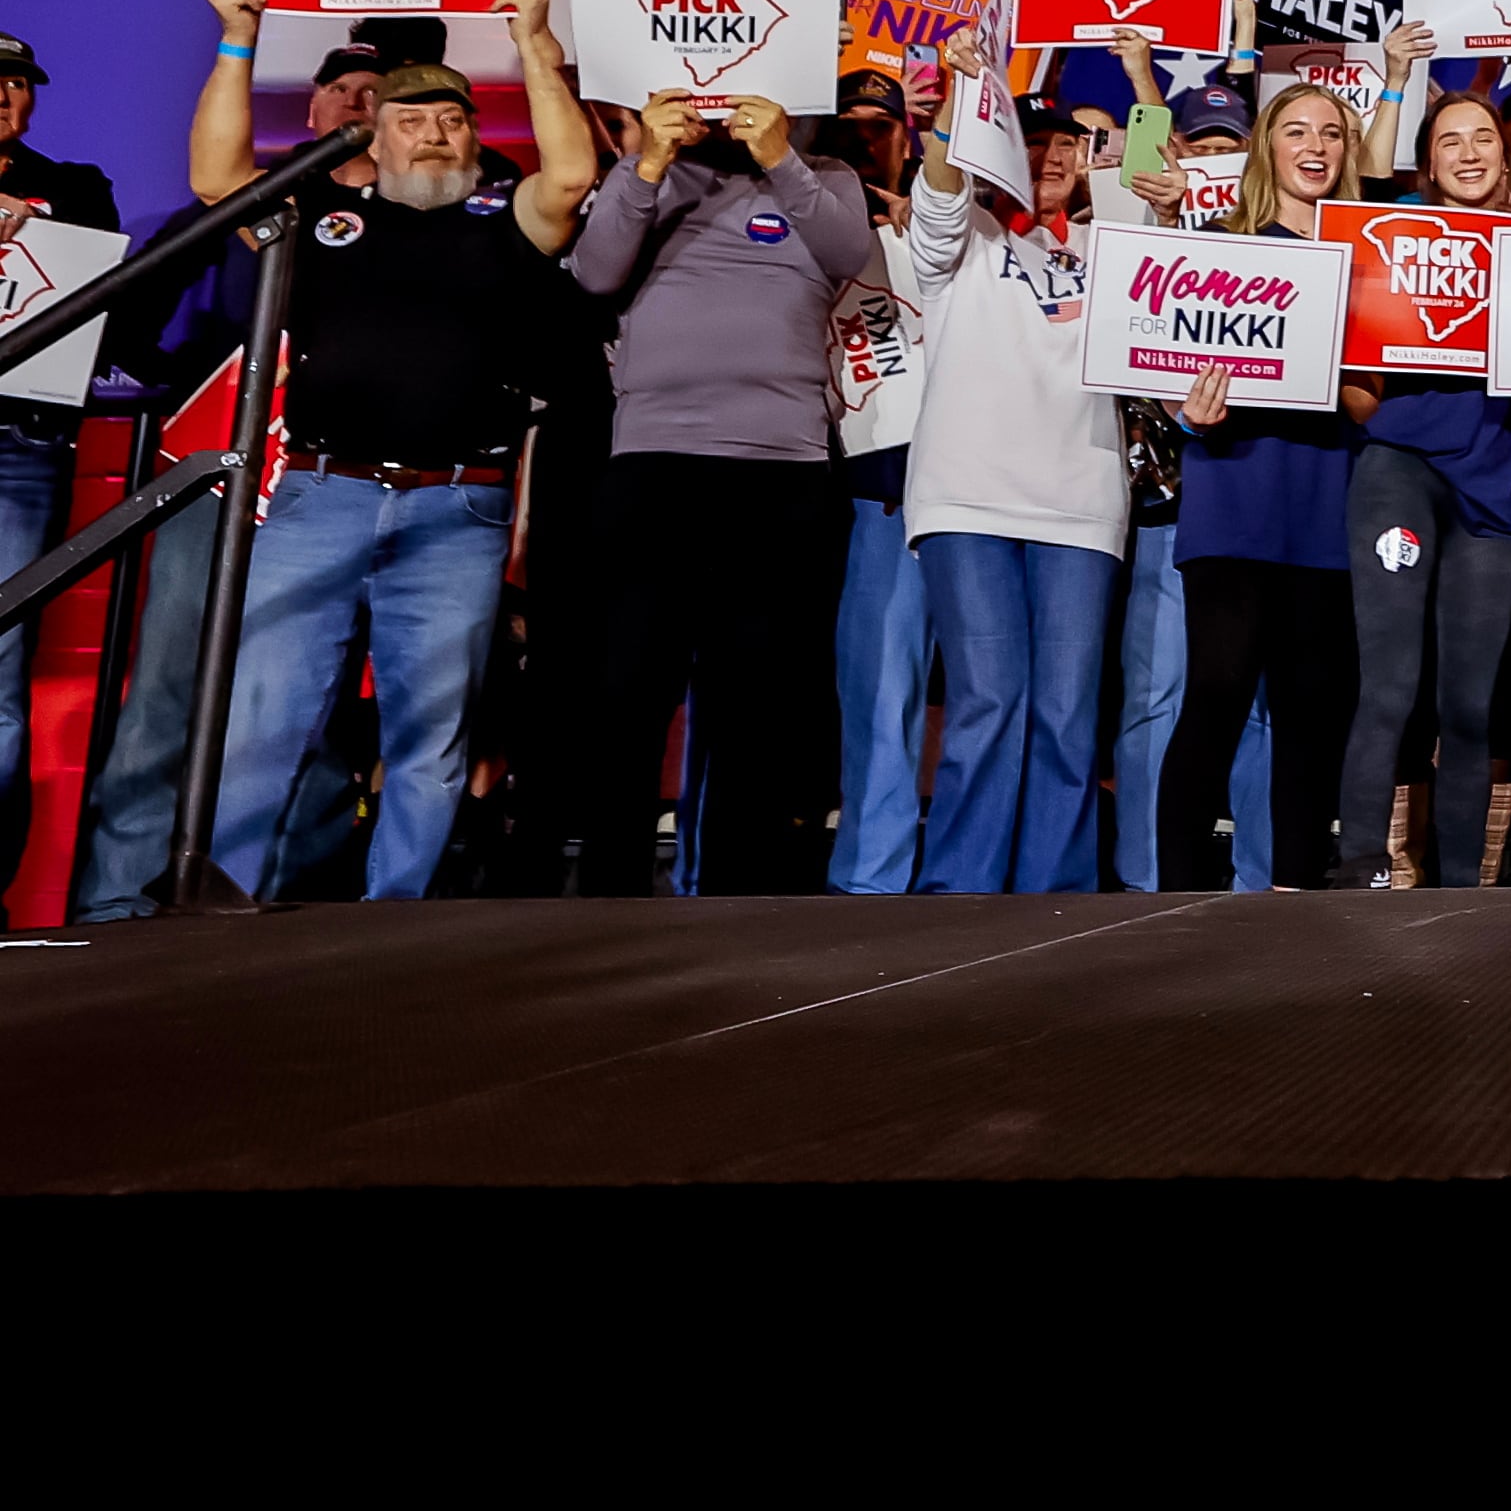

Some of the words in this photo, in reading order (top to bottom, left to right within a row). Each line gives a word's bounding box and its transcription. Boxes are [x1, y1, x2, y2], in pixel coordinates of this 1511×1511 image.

[651, 14, 755, 44] NIKKI
[868, 0, 971, 46] NIK
[1308, 65, 1363, 85] PICK
[1183, 184, 1238, 211] ICK
[1393, 236, 1477, 268] PICK
[1129, 256, 1300, 316] Women
[1390, 264, 1486, 299] NIKKI
[1411, 297, 1453, 307] FEBRUARY
[1453, 300, 1465, 308] 24
[860, 295, 907, 377] NIKKI
[1129, 317, 1167, 336] FOR
[1172, 308, 1286, 349] NIKKI
[837, 311, 878, 383] PICK
[1389, 349, 1480, 363] NikkiHaley.com
